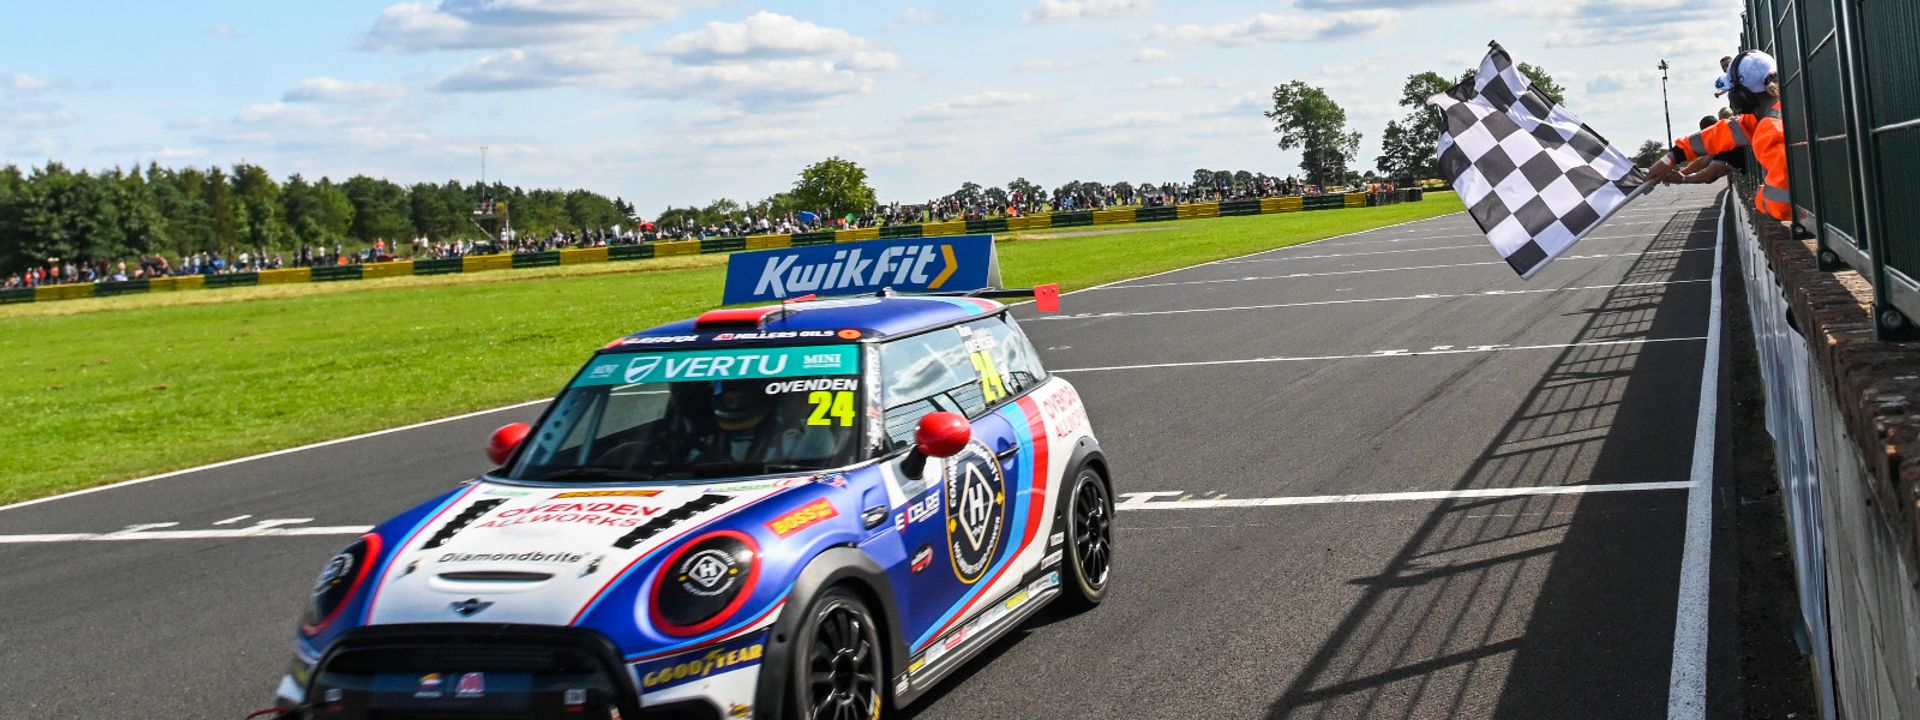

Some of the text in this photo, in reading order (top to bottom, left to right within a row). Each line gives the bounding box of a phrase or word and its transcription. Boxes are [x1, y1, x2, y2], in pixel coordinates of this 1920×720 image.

[754, 244, 936, 299] KwikFit
[733, 330, 834, 340] MILLERS OILS
[664, 354, 789, 379] VERTU
[803, 354, 842, 365] MINI
[765, 378, 859, 395] OVENDEN
[806, 391, 856, 427] 24
[497, 502, 663, 517] OVENDEN
[475, 513, 642, 529] ALLWORKS
[772, 508, 818, 536] BOSS
[437, 552, 585, 564] Diamondbrite
